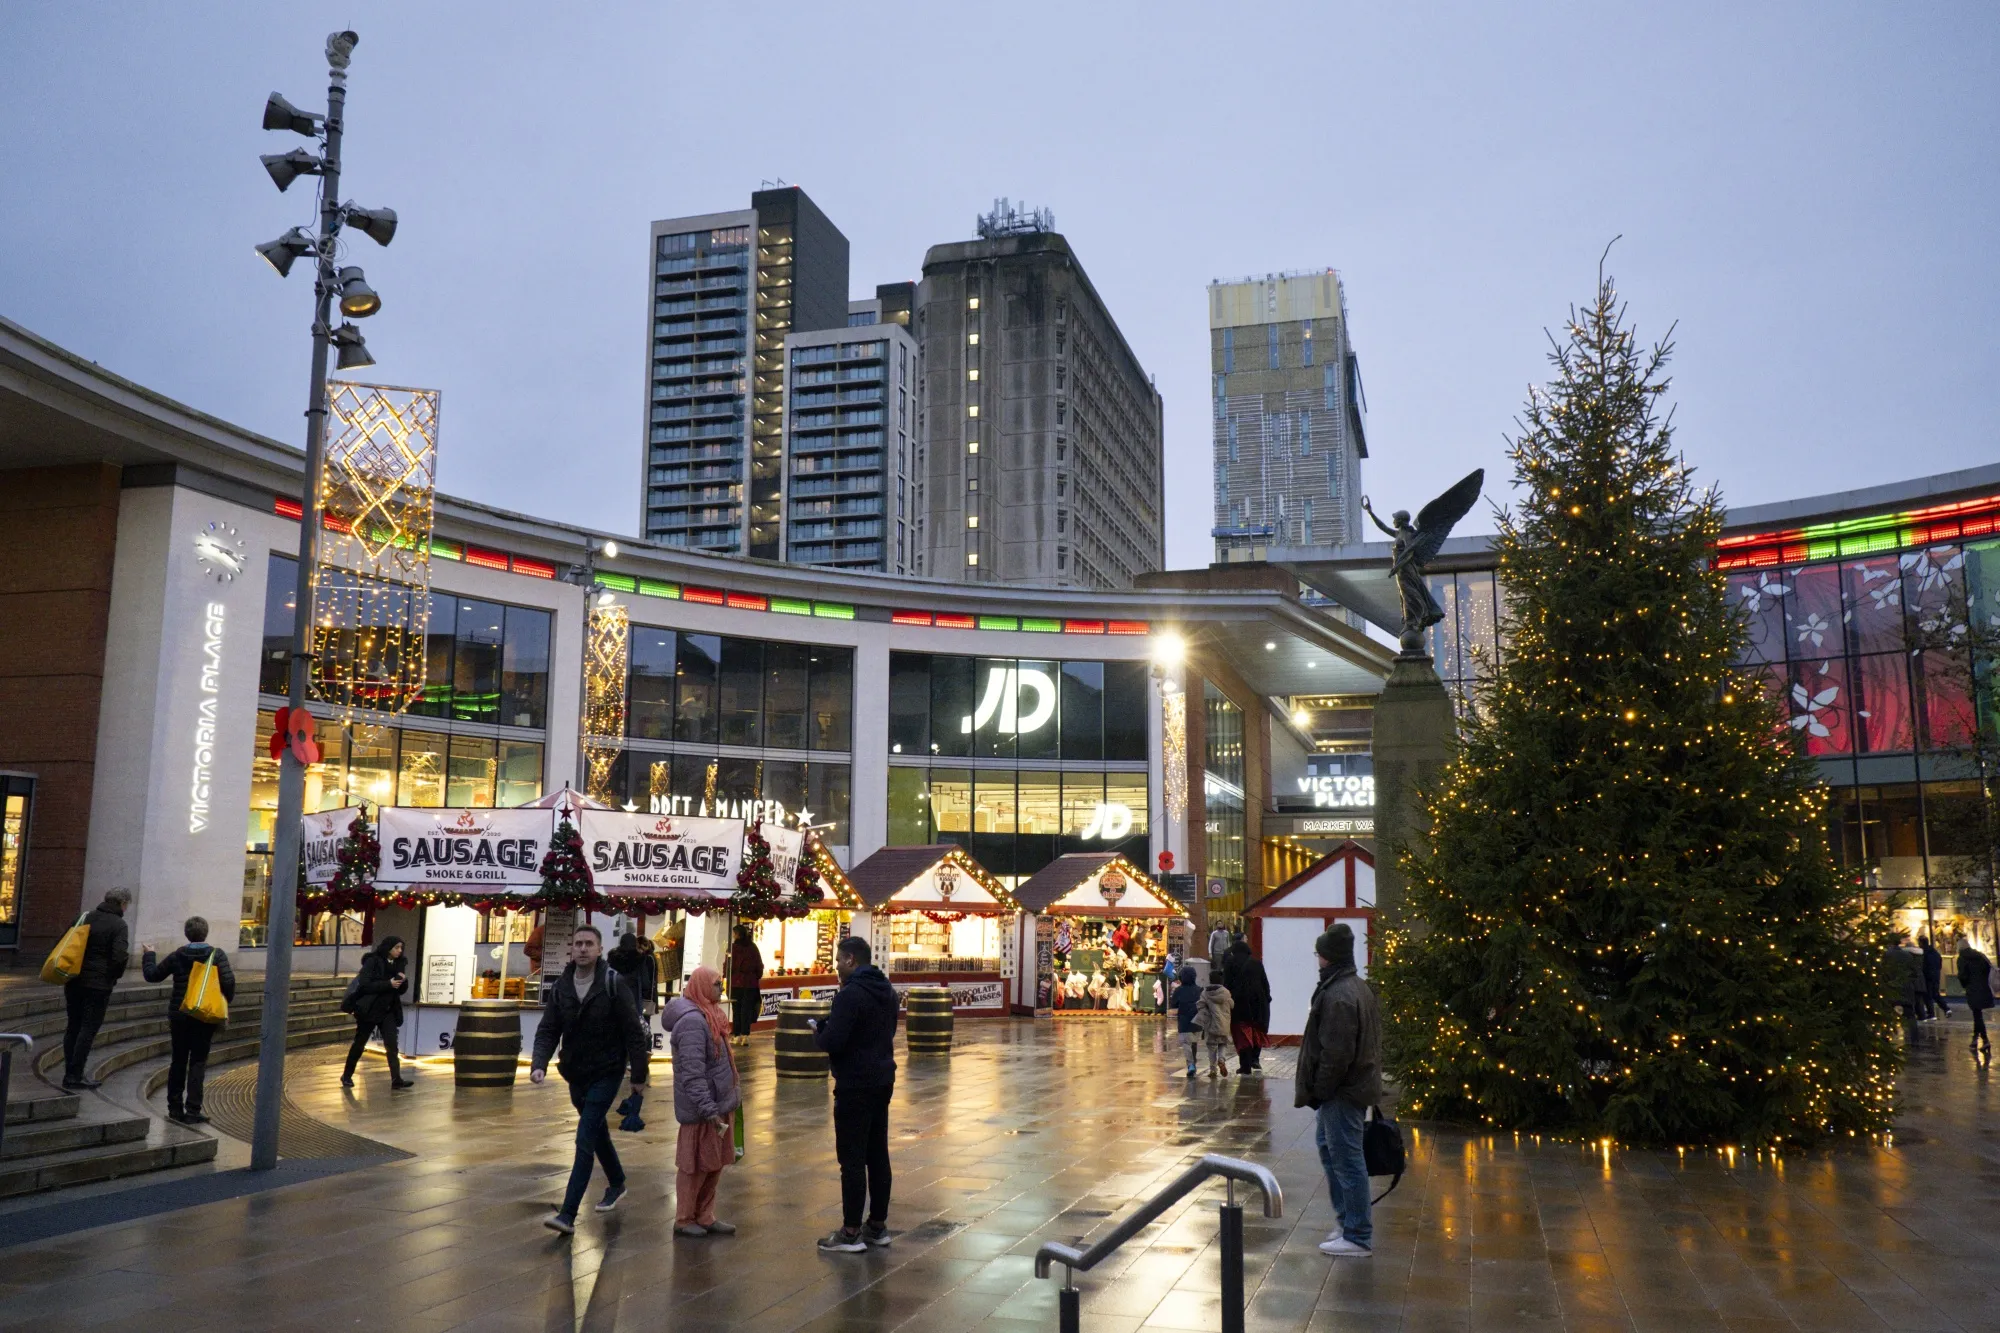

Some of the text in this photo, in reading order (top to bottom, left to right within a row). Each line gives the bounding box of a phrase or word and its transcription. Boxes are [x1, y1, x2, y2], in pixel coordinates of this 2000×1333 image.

[961, 667, 1056, 734] JD
[190, 602, 225, 834] VICTORIA PLACE
[1297, 776, 1375, 793] VICTOR
[1081, 803, 1133, 840] JD
[1303, 820, 1375, 831] MARKET WA
[393, 837, 538, 872] SAUSAGE
[593, 840, 729, 878] SAUSAGE
[425, 869, 507, 880] SMOKE & GRILL
[624, 873, 700, 884] SMOKE & GRILL
[973, 990, 1002, 1002] KISSES
